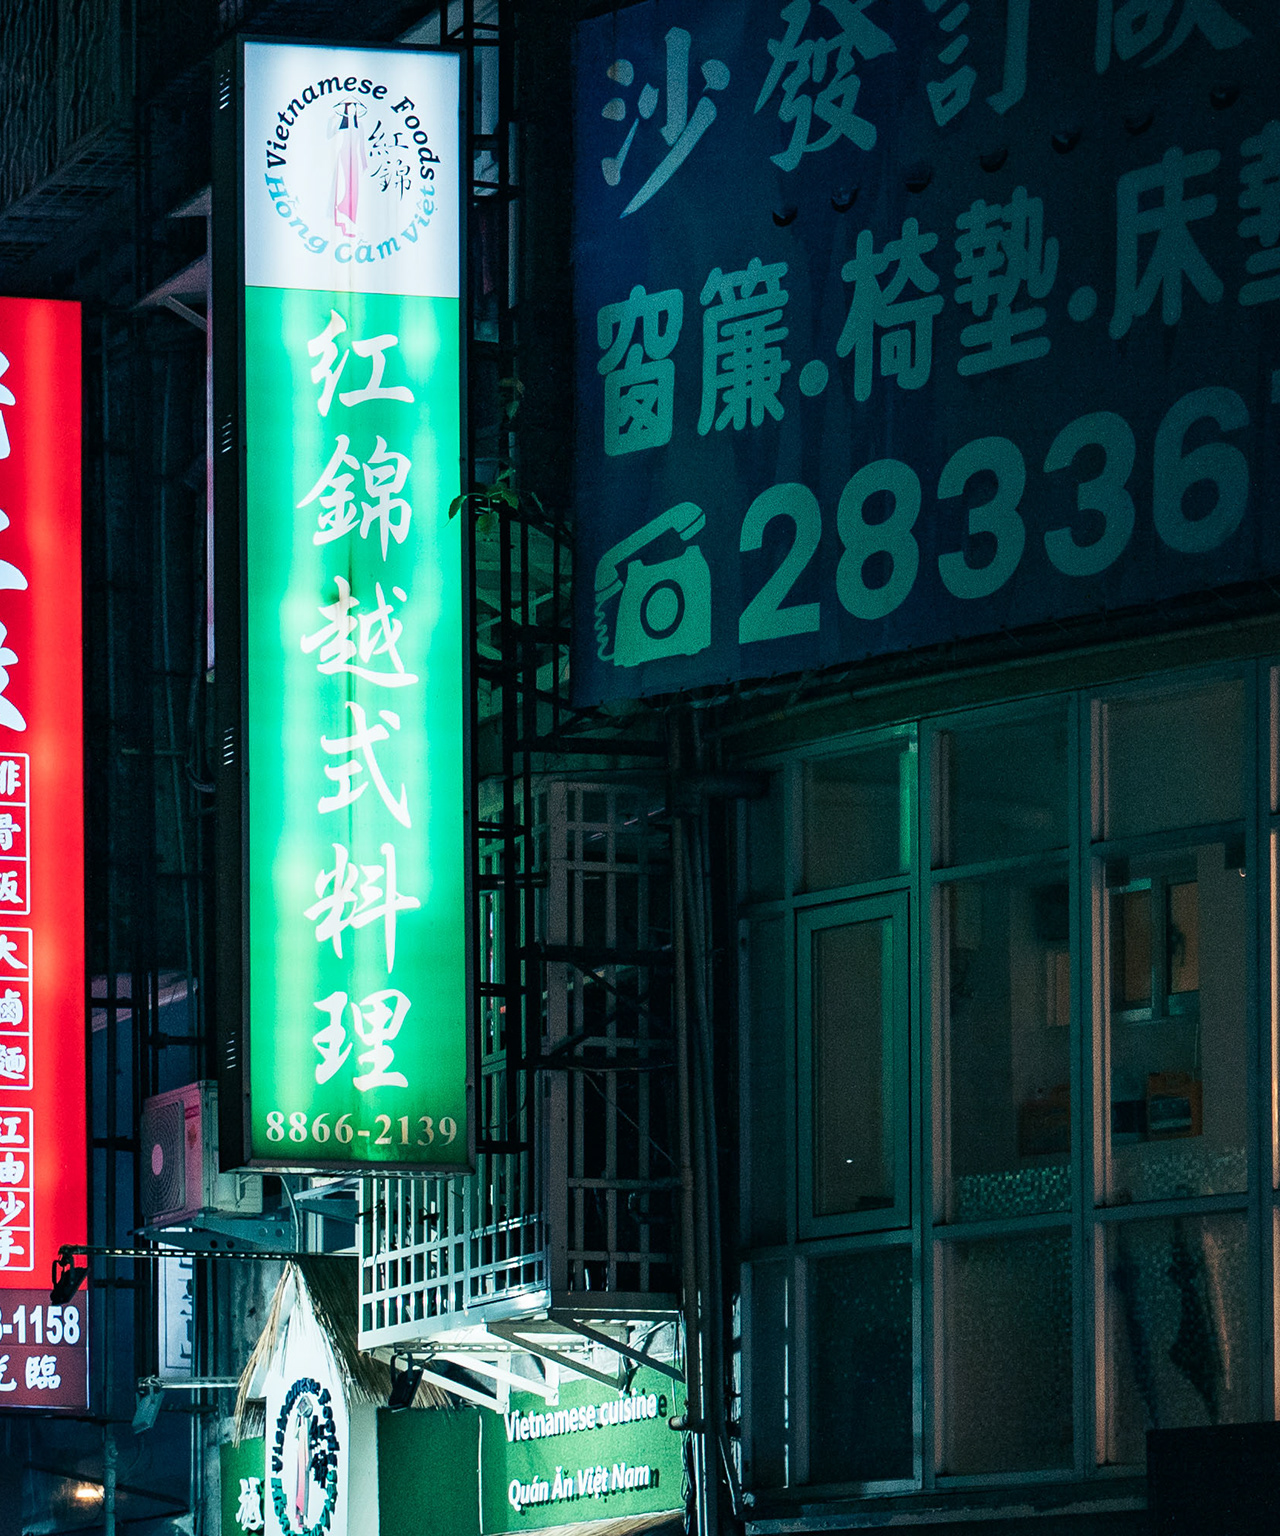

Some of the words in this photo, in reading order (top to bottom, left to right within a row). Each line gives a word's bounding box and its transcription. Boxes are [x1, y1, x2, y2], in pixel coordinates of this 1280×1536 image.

[266, 76, 389, 170] Vietnamese
[391, 96, 441, 182] Foods
[266, 1110, 458, 1146] 8866-2139
[504, 1403, 598, 1442] Vietnamese
[600, 1388, 659, 1431] cuisine
[508, 1478, 550, 1513] Quán
[551, 1469, 575, 1500] Ăn
[576, 1465, 608, 1503] Việt
[608, 1462, 651, 1491] Nam
